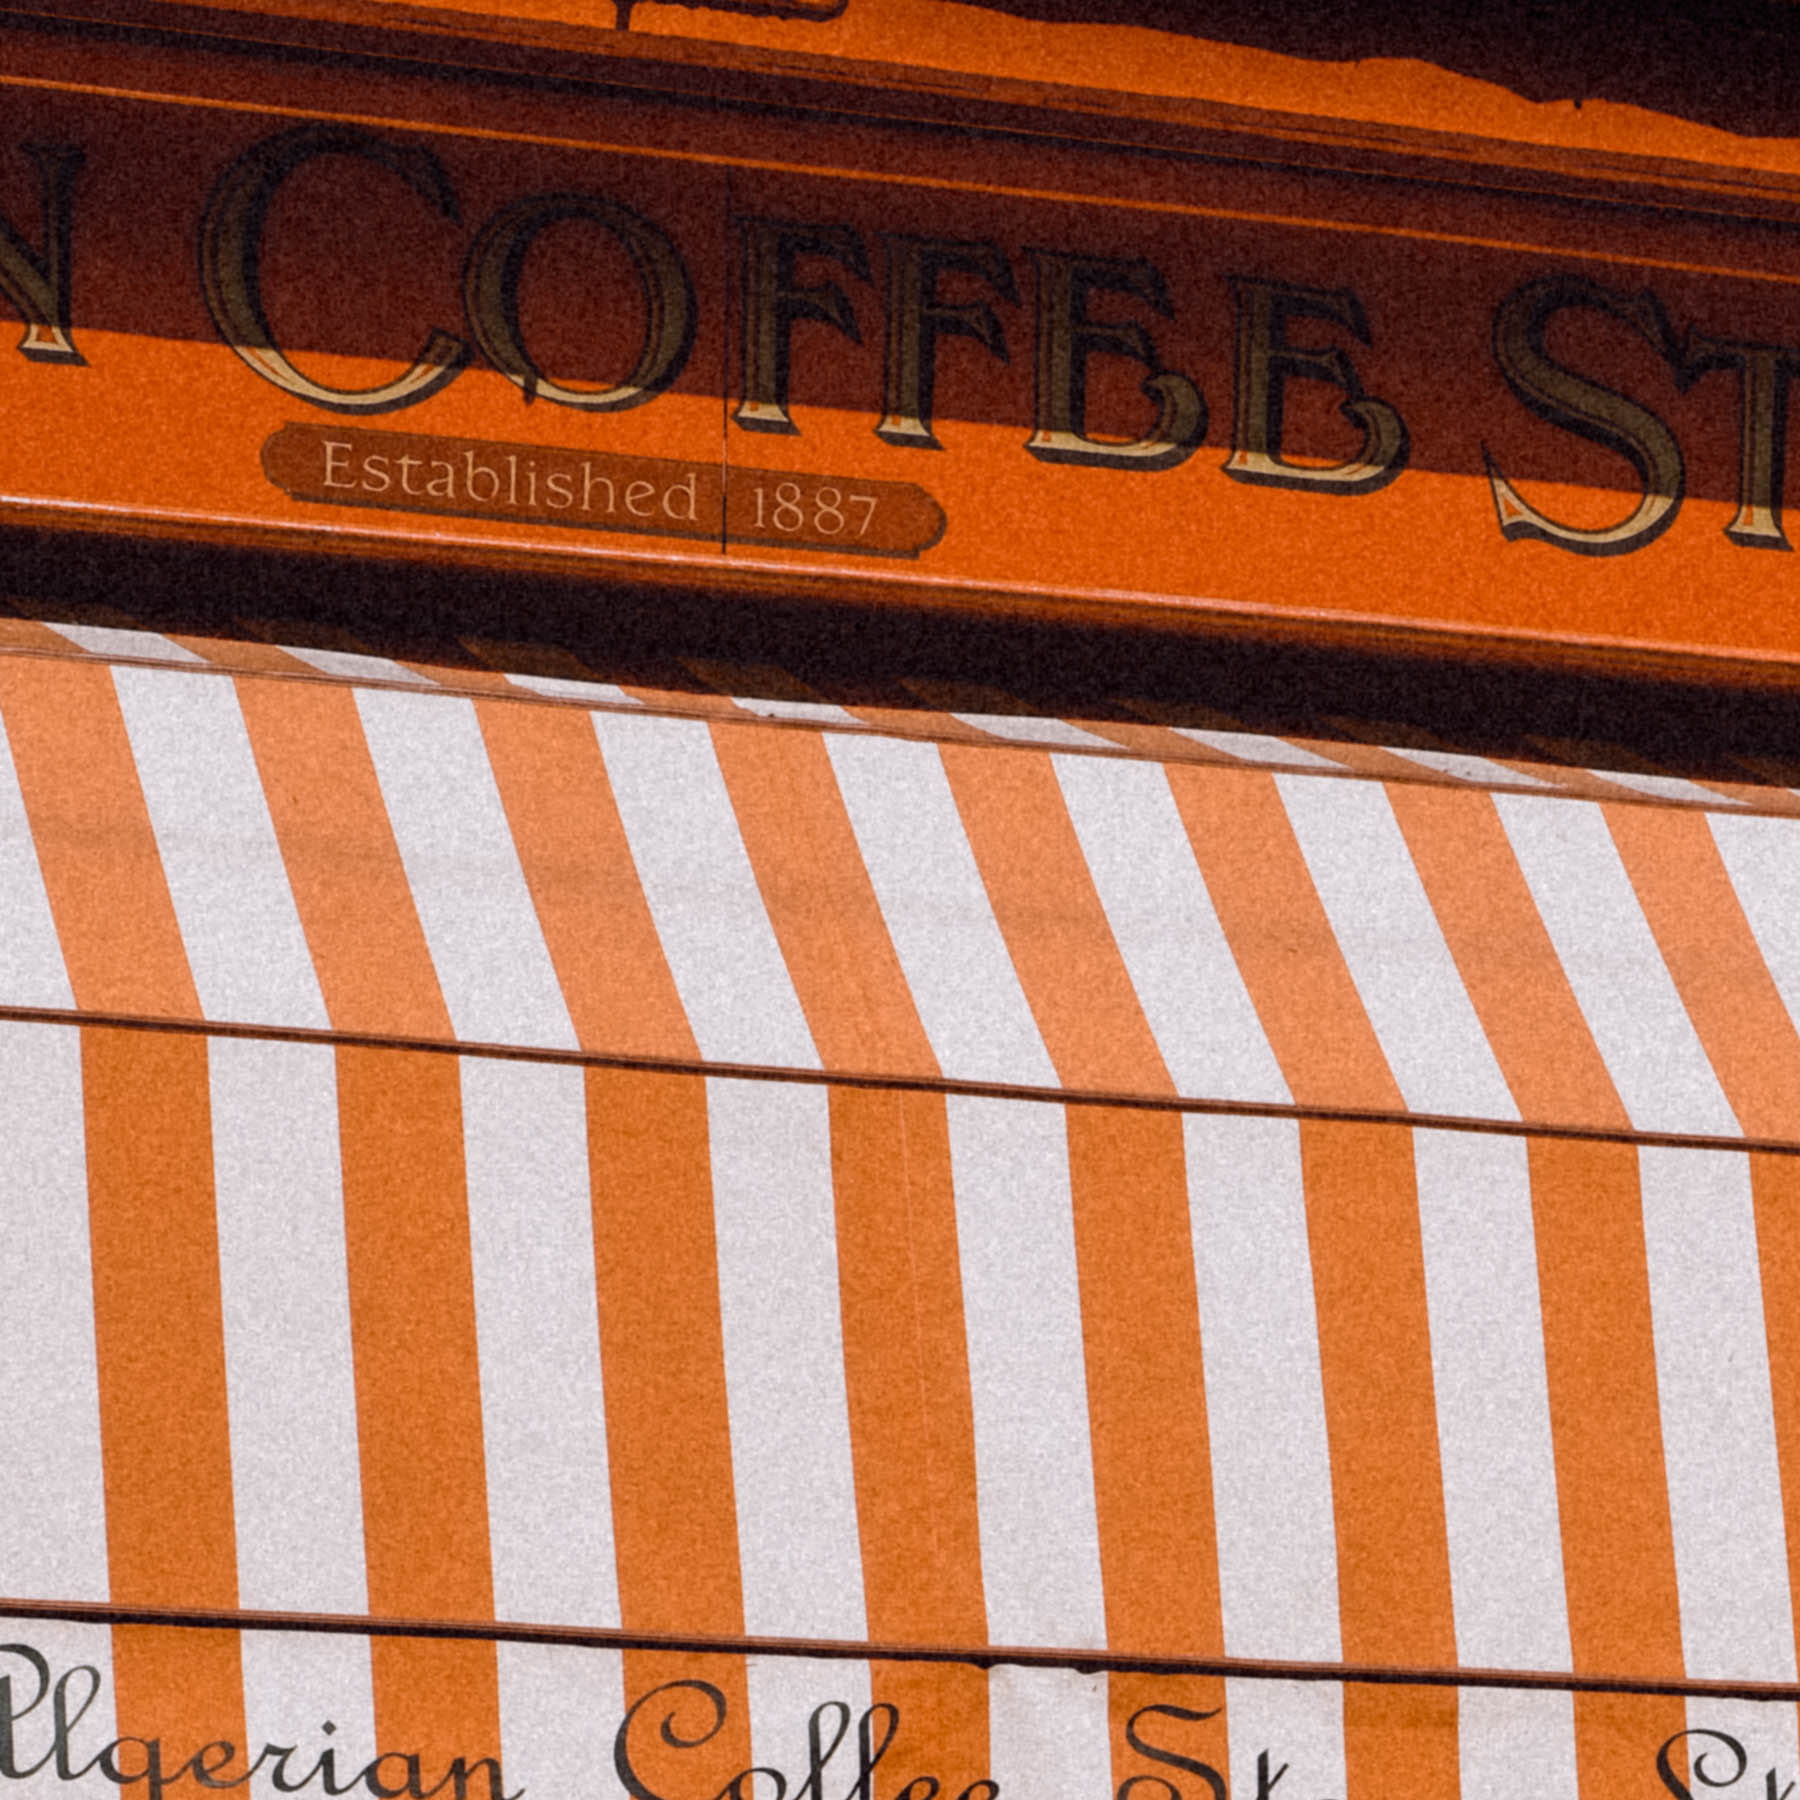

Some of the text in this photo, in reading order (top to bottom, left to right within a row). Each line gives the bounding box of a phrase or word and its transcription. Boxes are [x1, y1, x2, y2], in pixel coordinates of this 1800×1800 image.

[197, 120, 1412, 498] COFFEE
[320, 440, 878, 541] Established 1887
